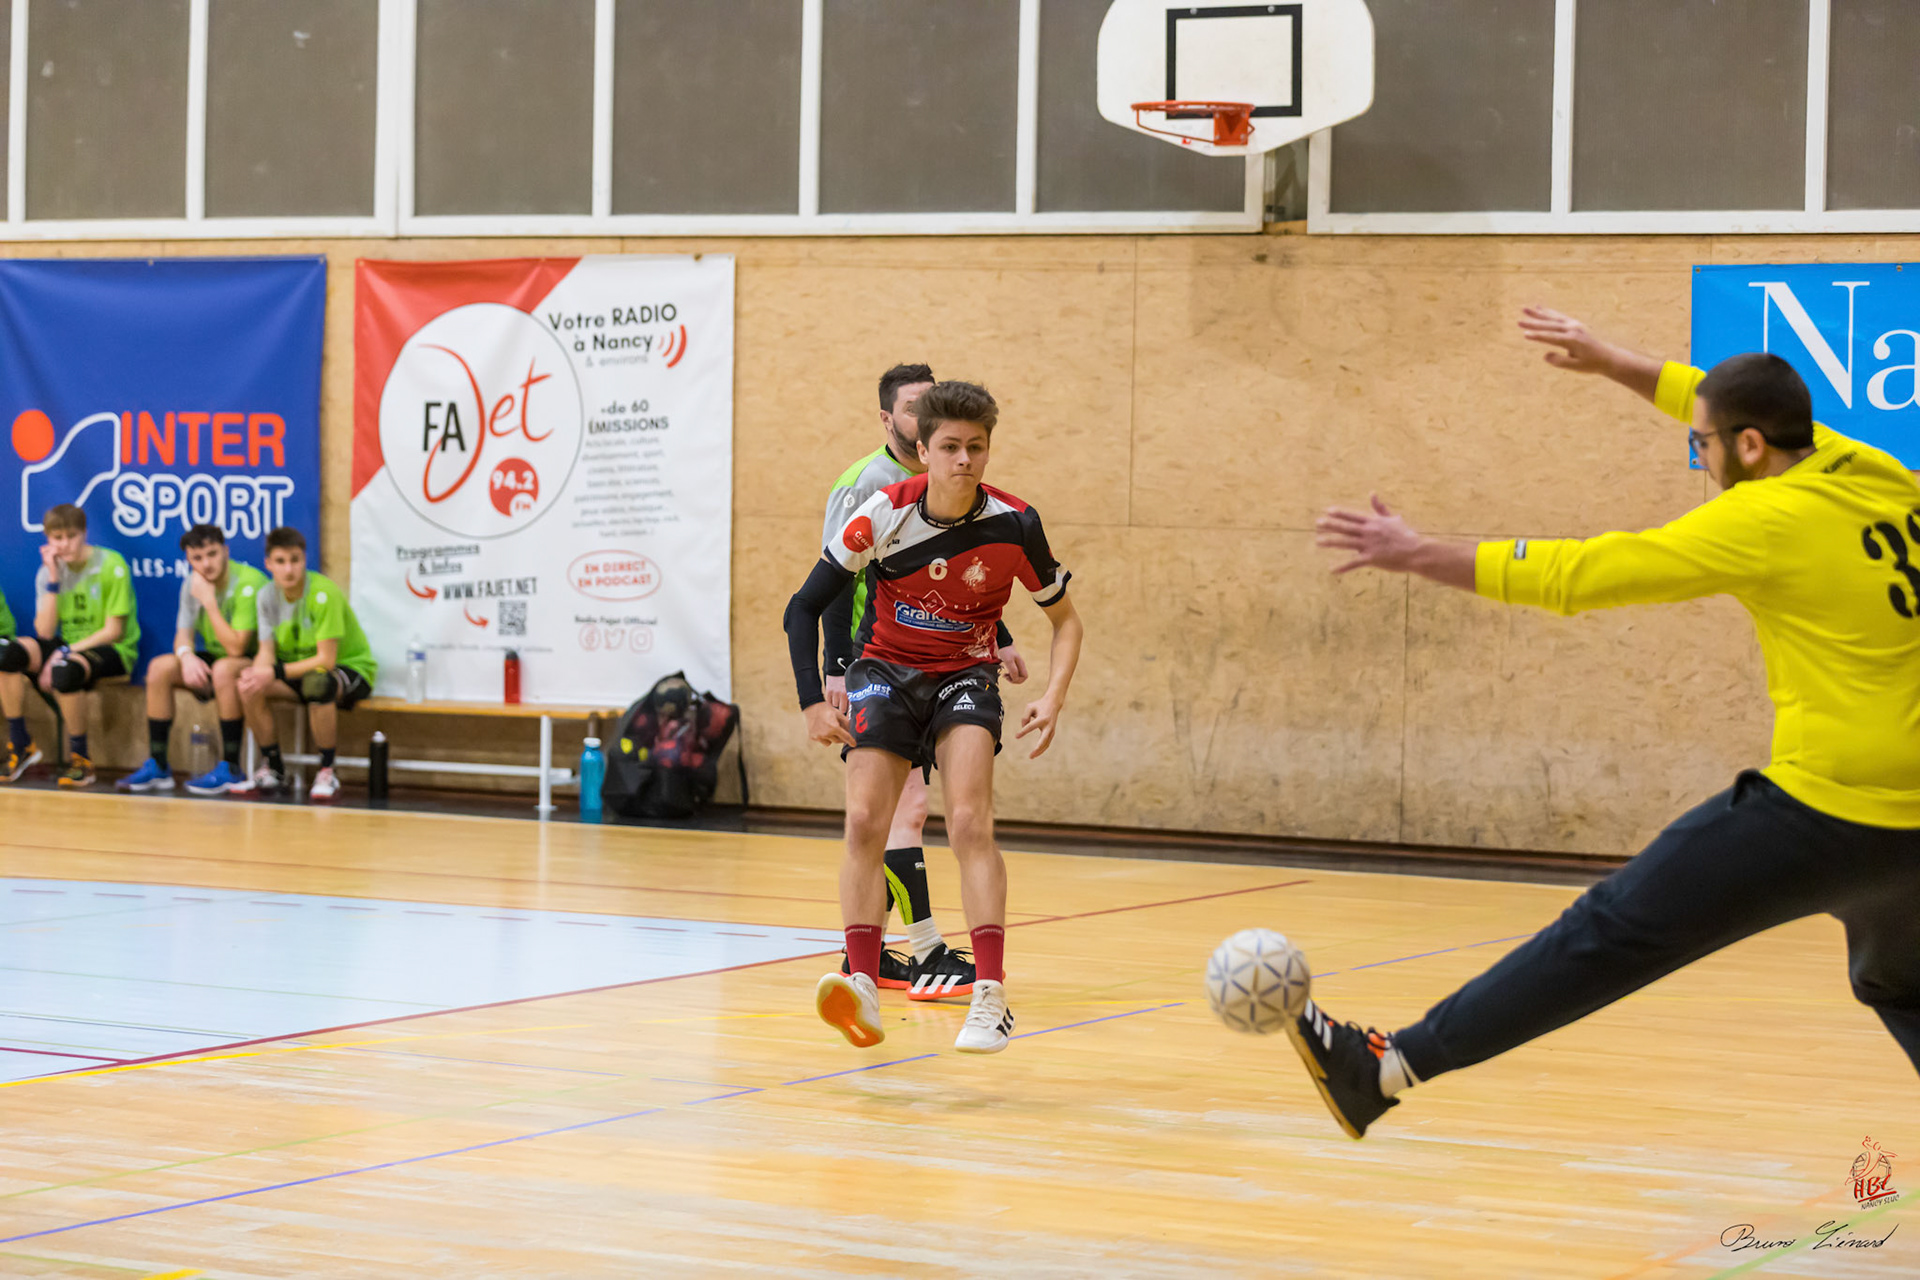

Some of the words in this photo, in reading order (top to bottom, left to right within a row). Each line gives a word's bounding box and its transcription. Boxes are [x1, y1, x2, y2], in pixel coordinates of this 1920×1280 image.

[549, 311, 605, 331] Votre
[612, 303, 677, 326] RADIO
[574, 334, 585, 352] à
[593, 333, 653, 353] Nancy
[600, 355, 649, 367] environs
[631, 400, 649, 413] 60
[120, 411, 287, 468] INTER
[492, 470, 535, 491] 94.2
[111, 472, 295, 539] SPORT
[396, 543, 481, 560] Programmes
[603, 560, 646, 573] DIRECT
[928, 557, 948, 581] 6
[443, 577, 538, 600] WWW.FAJET.NET
[596, 574, 652, 587] PODCAST
[952, 704, 976, 712] SELECT
